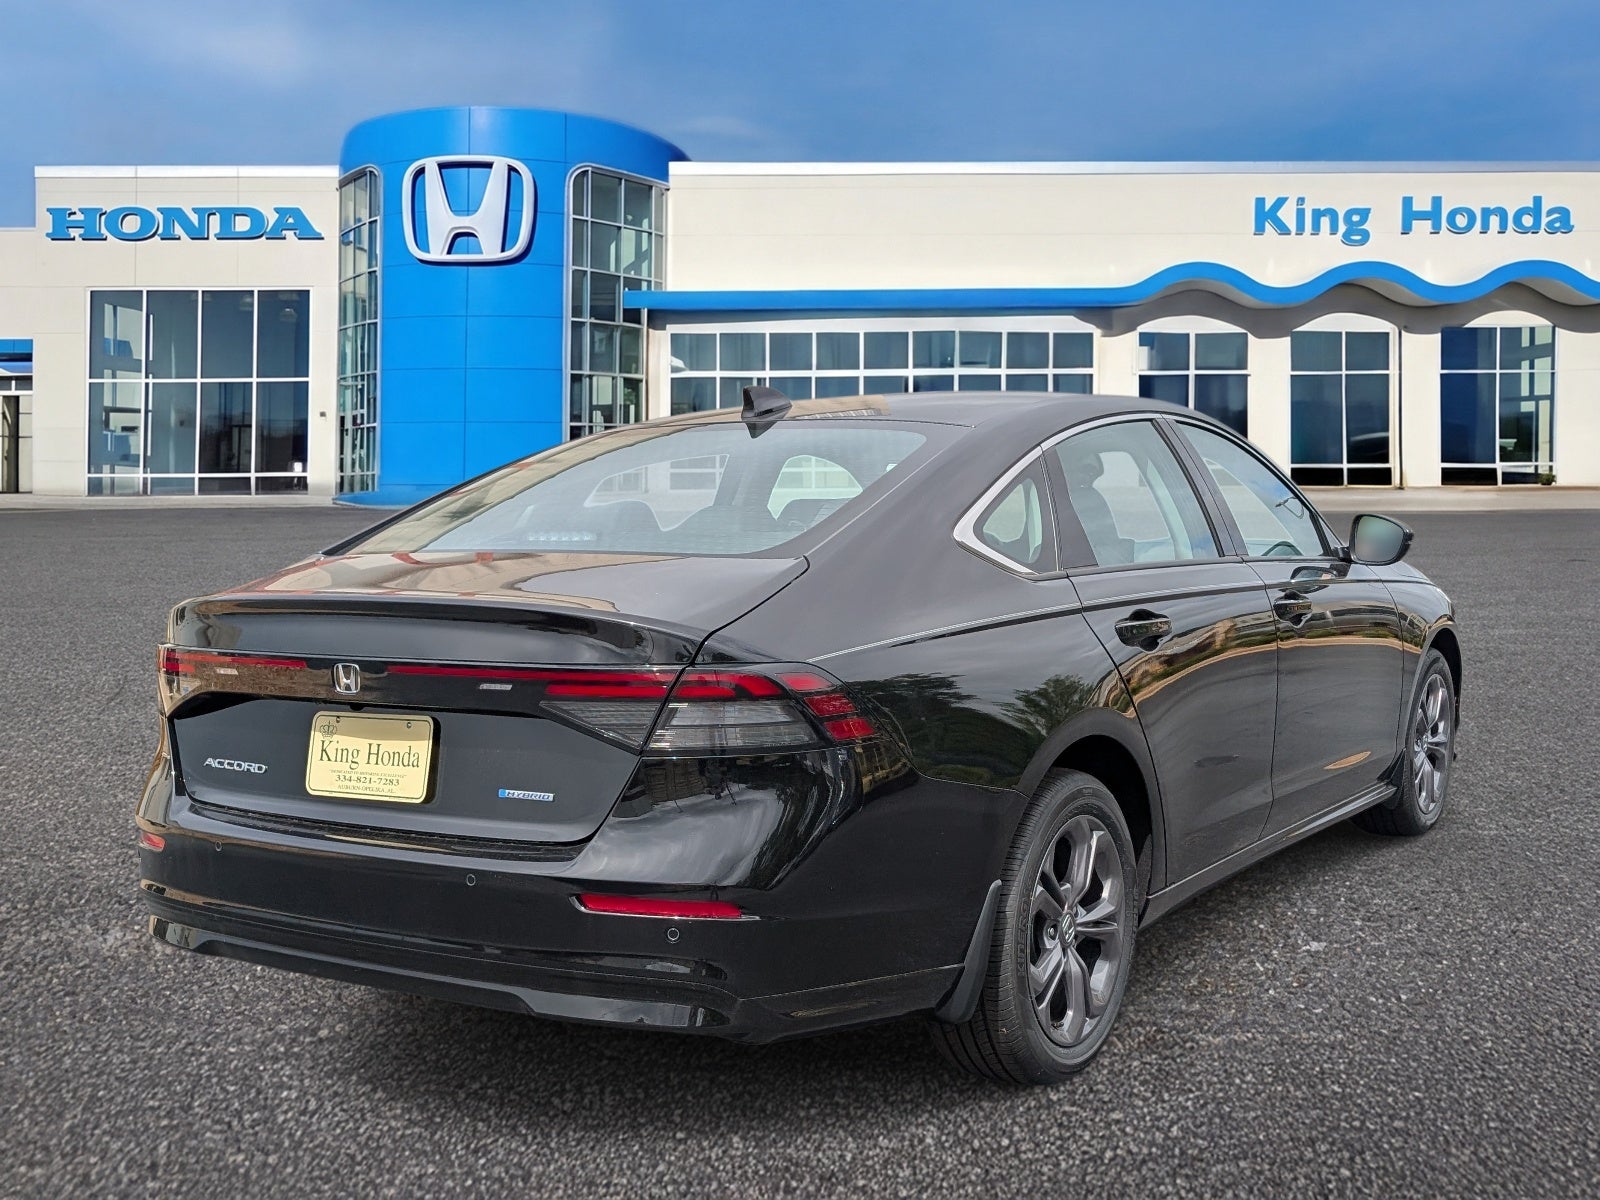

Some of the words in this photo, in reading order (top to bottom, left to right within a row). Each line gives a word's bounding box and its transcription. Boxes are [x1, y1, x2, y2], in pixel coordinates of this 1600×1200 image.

[45, 206, 325, 241] HONDA
[1253, 196, 1372, 246] King
[1400, 195, 1575, 235] Honda
[203, 757, 266, 774] ACCORD
[319, 739, 361, 770] King
[365, 742, 420, 768] Honda
[335, 775, 400, 787] 334-821-7283
[505, 790, 552, 801] HYBRID
